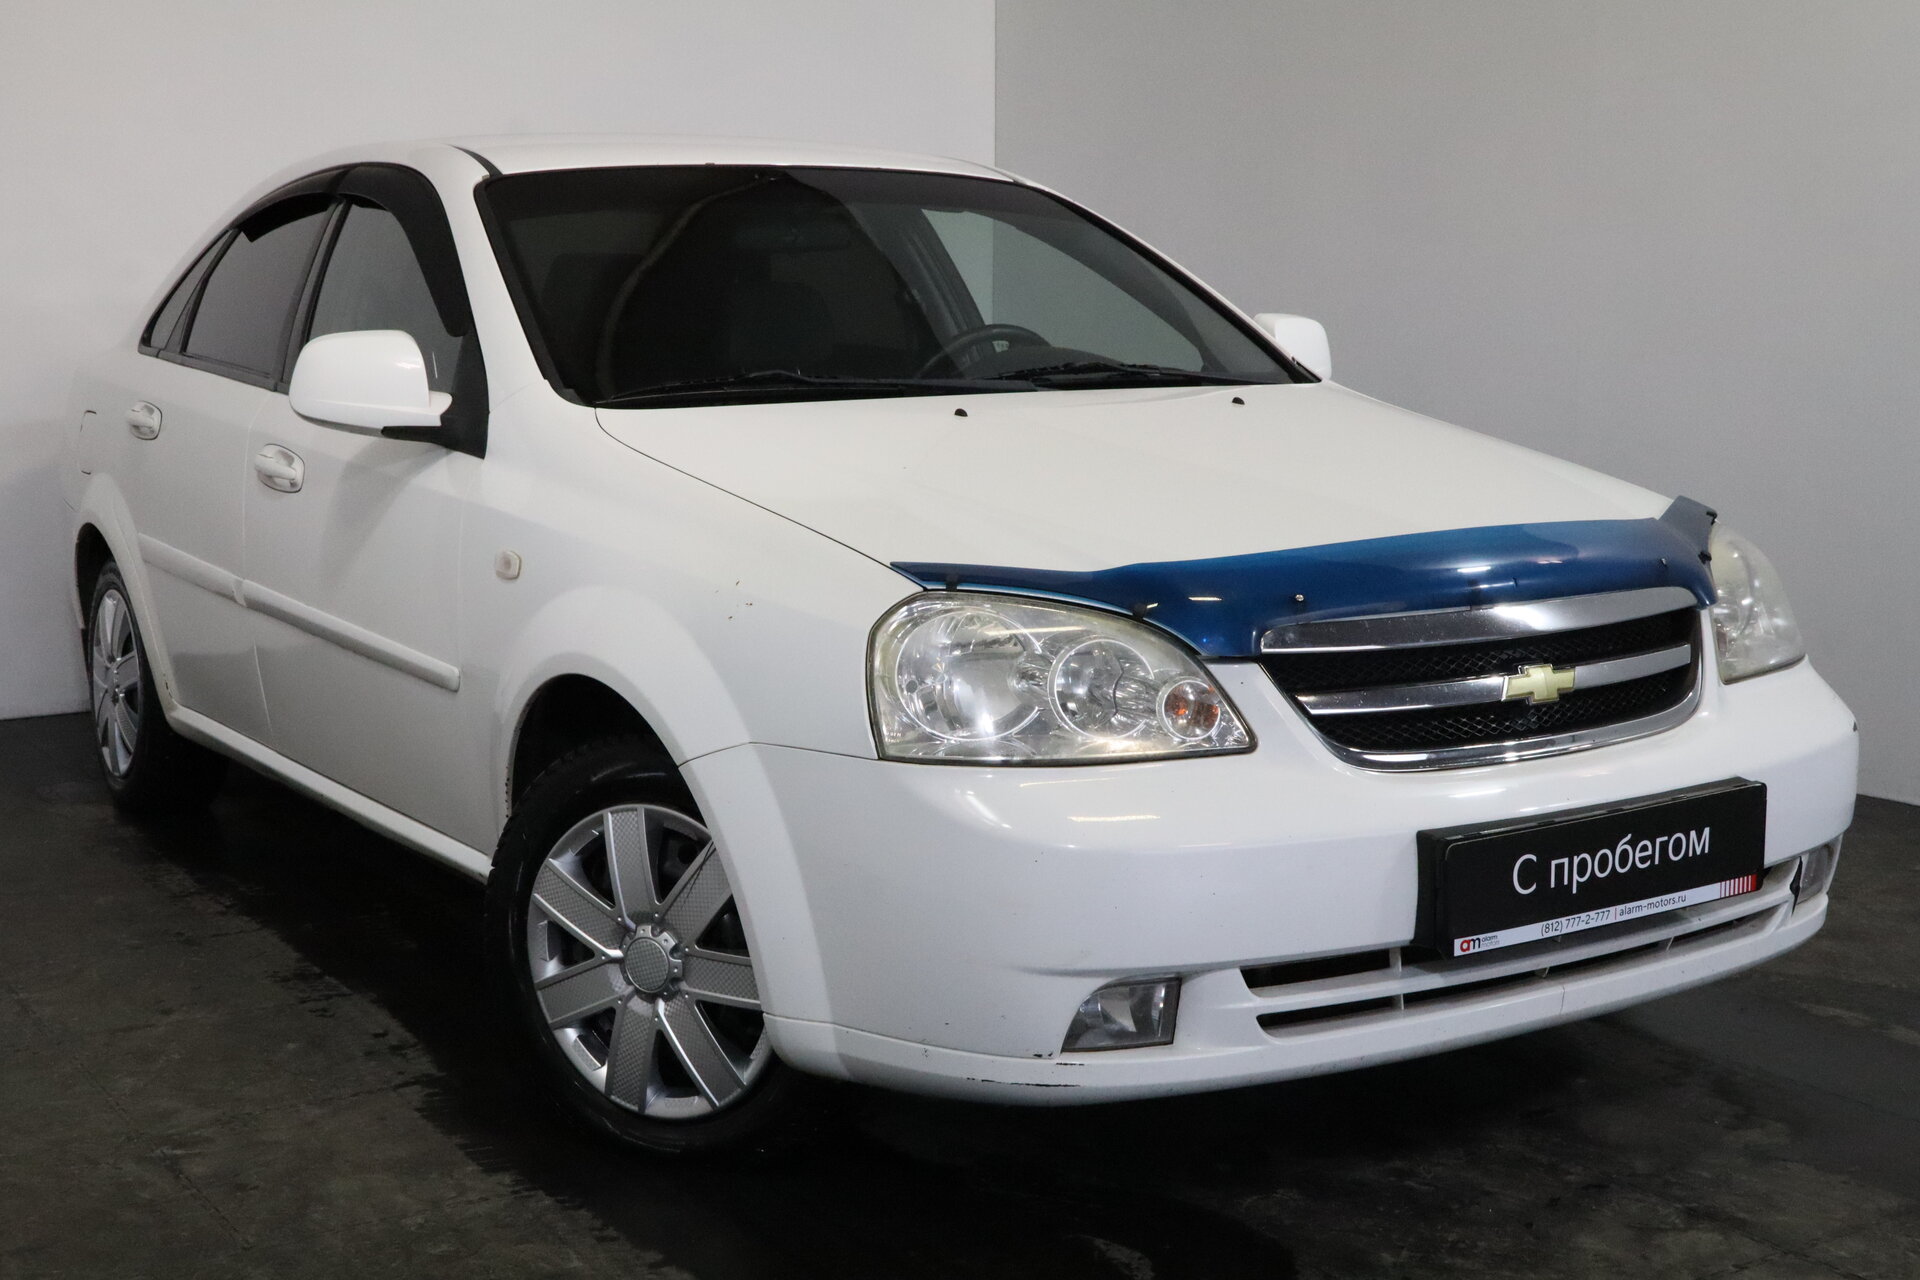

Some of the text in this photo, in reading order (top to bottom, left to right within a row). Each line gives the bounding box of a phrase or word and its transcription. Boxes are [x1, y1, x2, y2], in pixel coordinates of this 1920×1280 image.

[1512, 826, 1711, 895] С пробегом
[1541, 894, 1687, 937] (812) 777-2-777 alarm-motors.ru
